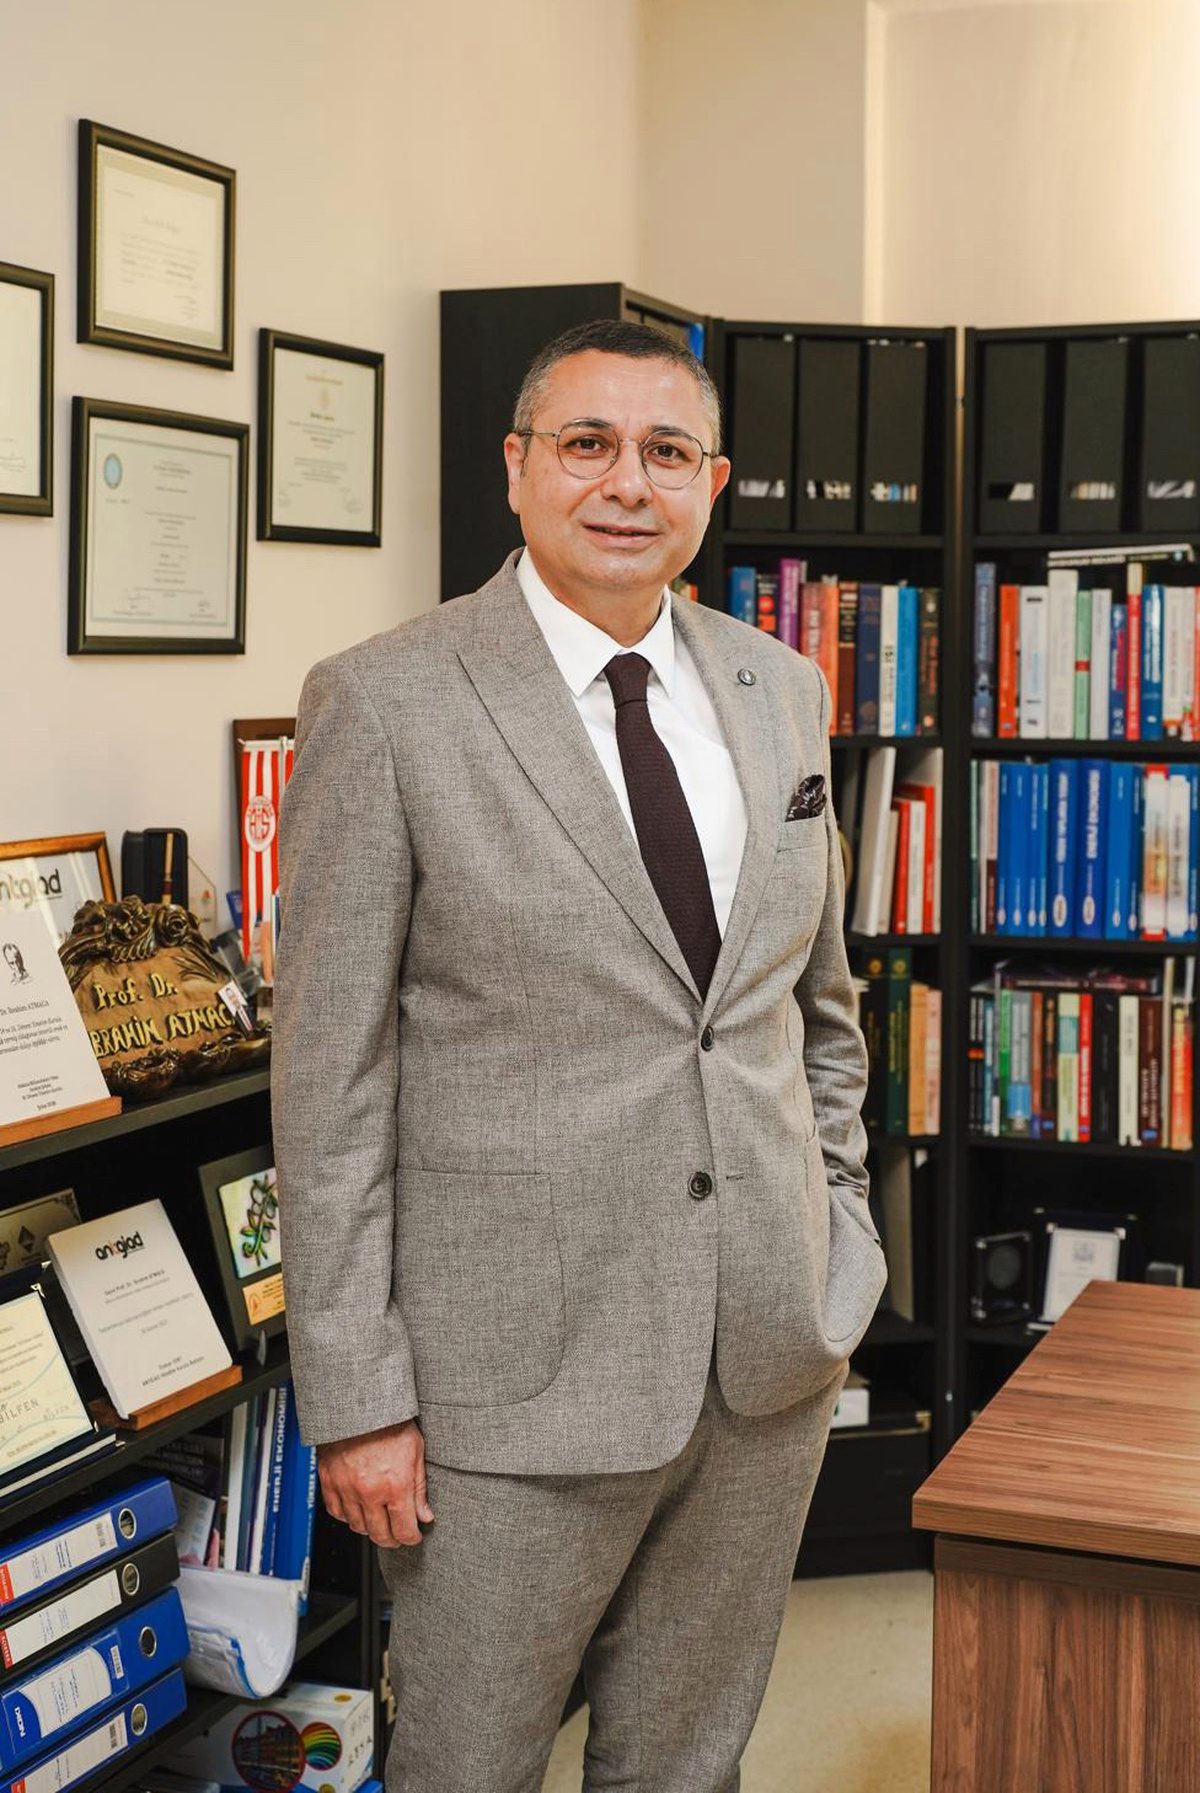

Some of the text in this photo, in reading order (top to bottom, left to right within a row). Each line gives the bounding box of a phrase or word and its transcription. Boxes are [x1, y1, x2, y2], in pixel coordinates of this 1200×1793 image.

[94, 972, 179, 1009] Prof. Dr.
[89, 1016, 163, 1058] BRAHİM
[166, 1003, 236, 1041] ATMAC
